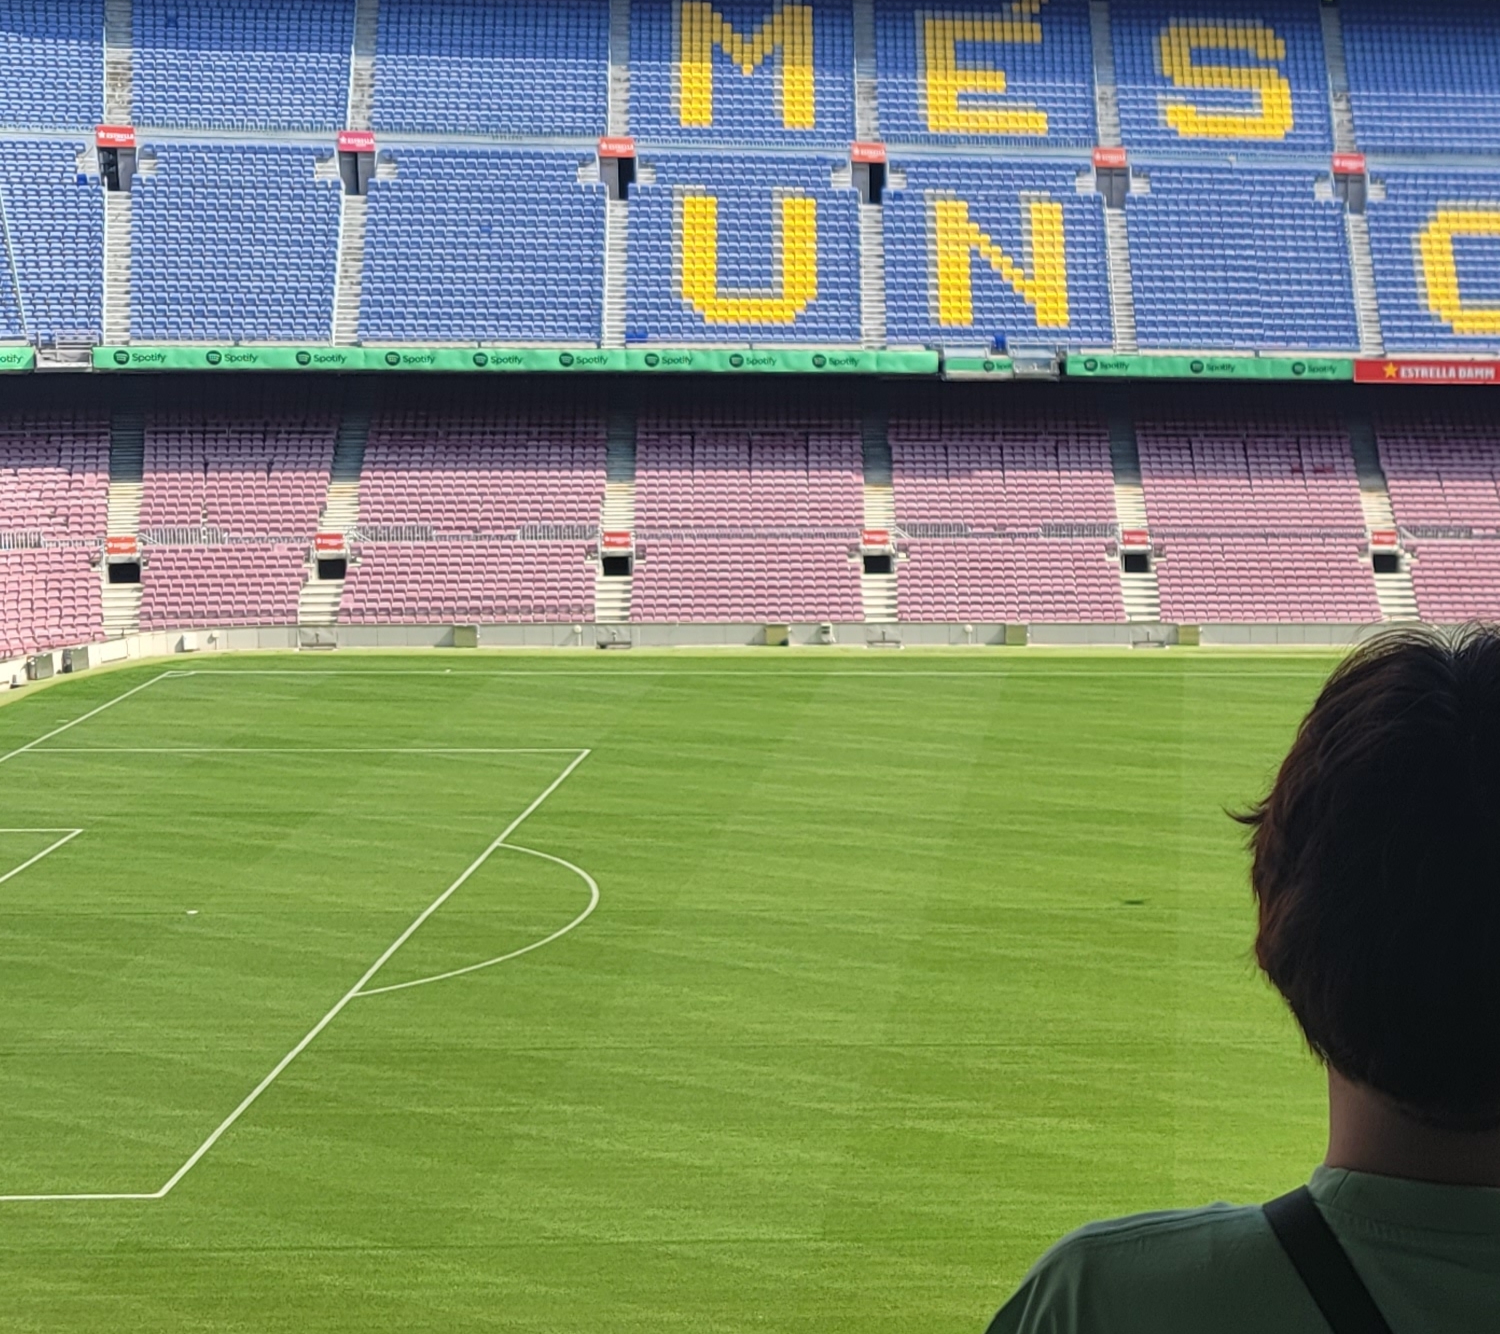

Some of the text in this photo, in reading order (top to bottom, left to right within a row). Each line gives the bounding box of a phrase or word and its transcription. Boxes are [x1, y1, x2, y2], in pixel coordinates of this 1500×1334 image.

[681, 194, 1071, 329] UN
[132, 352, 166, 364] Spotify
[224, 352, 258, 364] Spotify
[314, 353, 347, 364] Spotify
[403, 354, 436, 365] Spotify
[491, 354, 523, 365] Spotify
[576, 355, 608, 365] Spotify
[662, 355, 693, 366] Spotify
[1400, 366, 1496, 380] ESTRELLA DAMM
